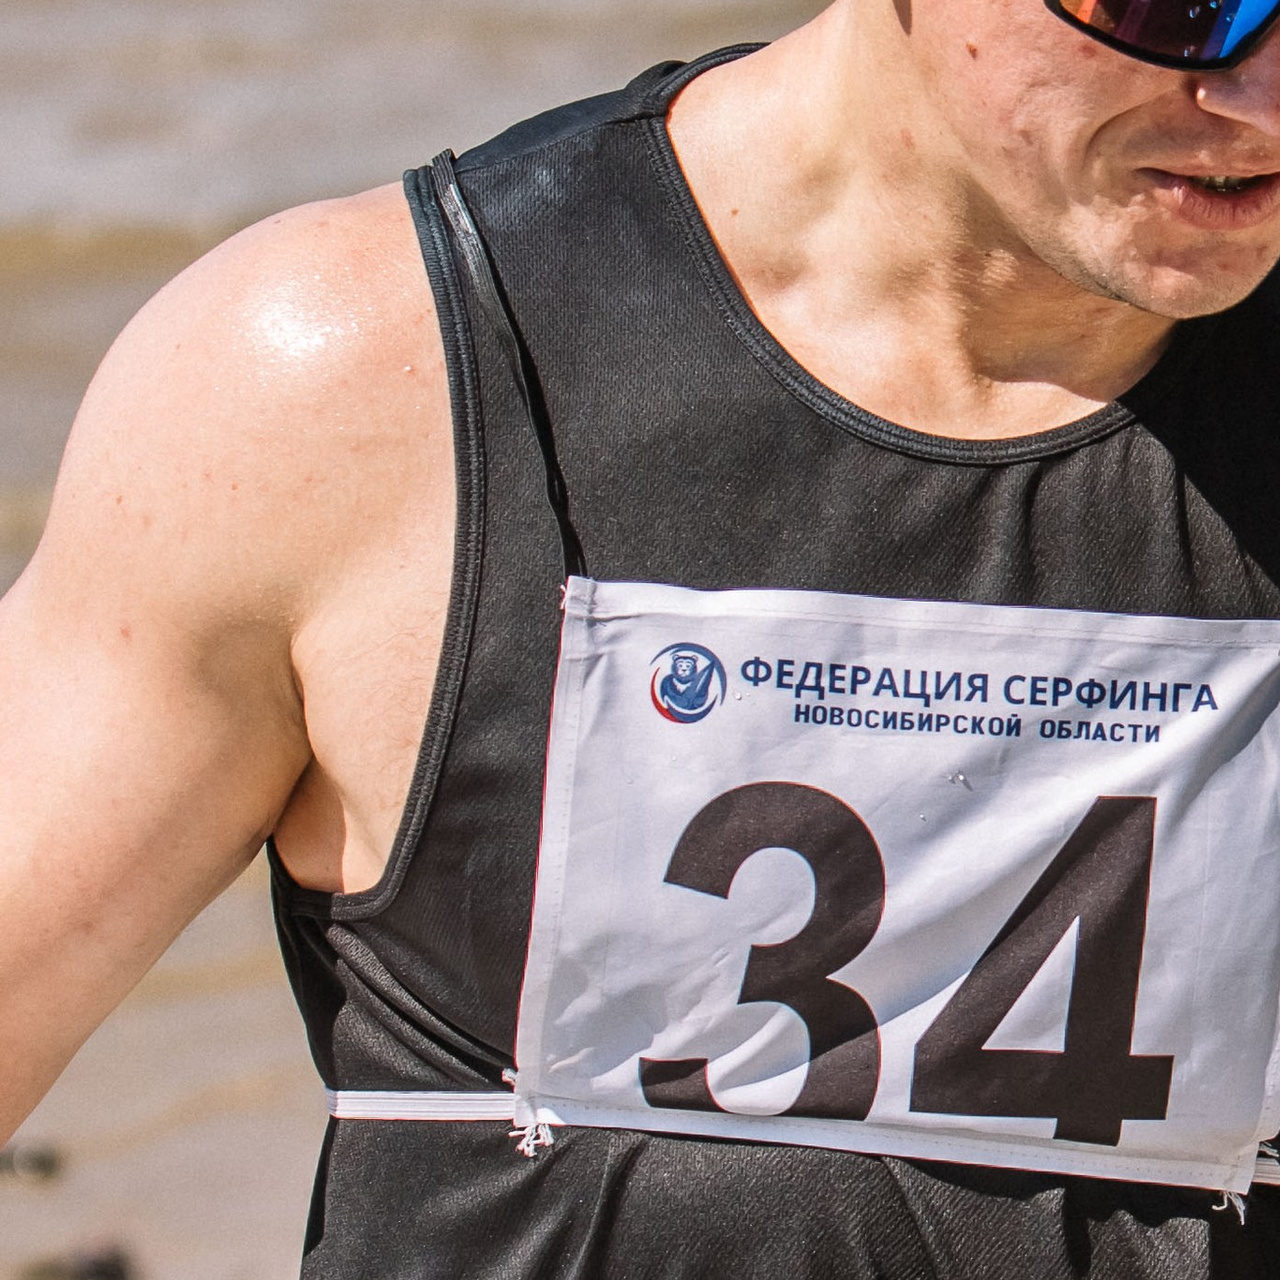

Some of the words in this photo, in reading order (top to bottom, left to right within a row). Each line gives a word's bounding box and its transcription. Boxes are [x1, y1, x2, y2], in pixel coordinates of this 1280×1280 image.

[740, 655, 990, 708] ФЕДЕРАЦИЯ
[1002, 674, 1219, 713] СЕРФИНГА
[794, 704, 1022, 738] НОВОСИБИРСКОЙ
[1038, 719, 1161, 743] ОБЛАСТИ
[638, 780, 1176, 1147] 34
